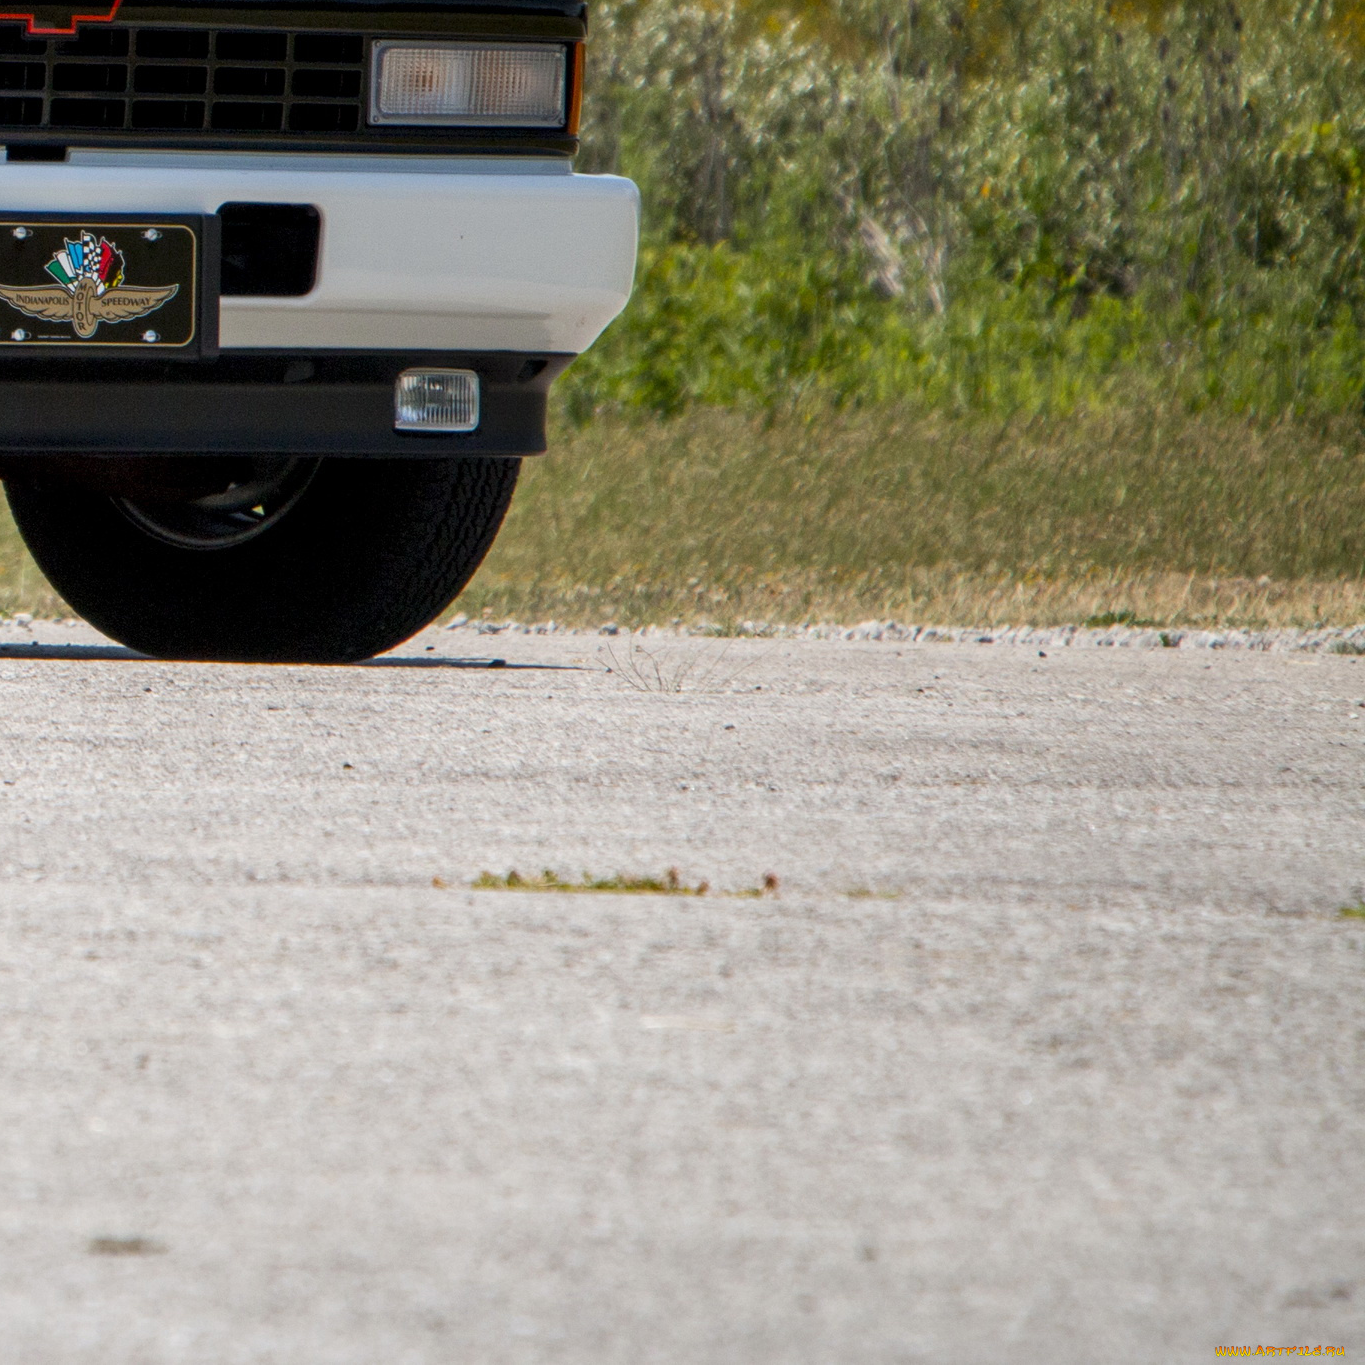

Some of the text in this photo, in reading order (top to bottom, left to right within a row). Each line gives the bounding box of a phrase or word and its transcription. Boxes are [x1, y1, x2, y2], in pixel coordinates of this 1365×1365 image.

[15, 283, 151, 331] INDIANAPOLIS MOTOR SPEEDWAY
